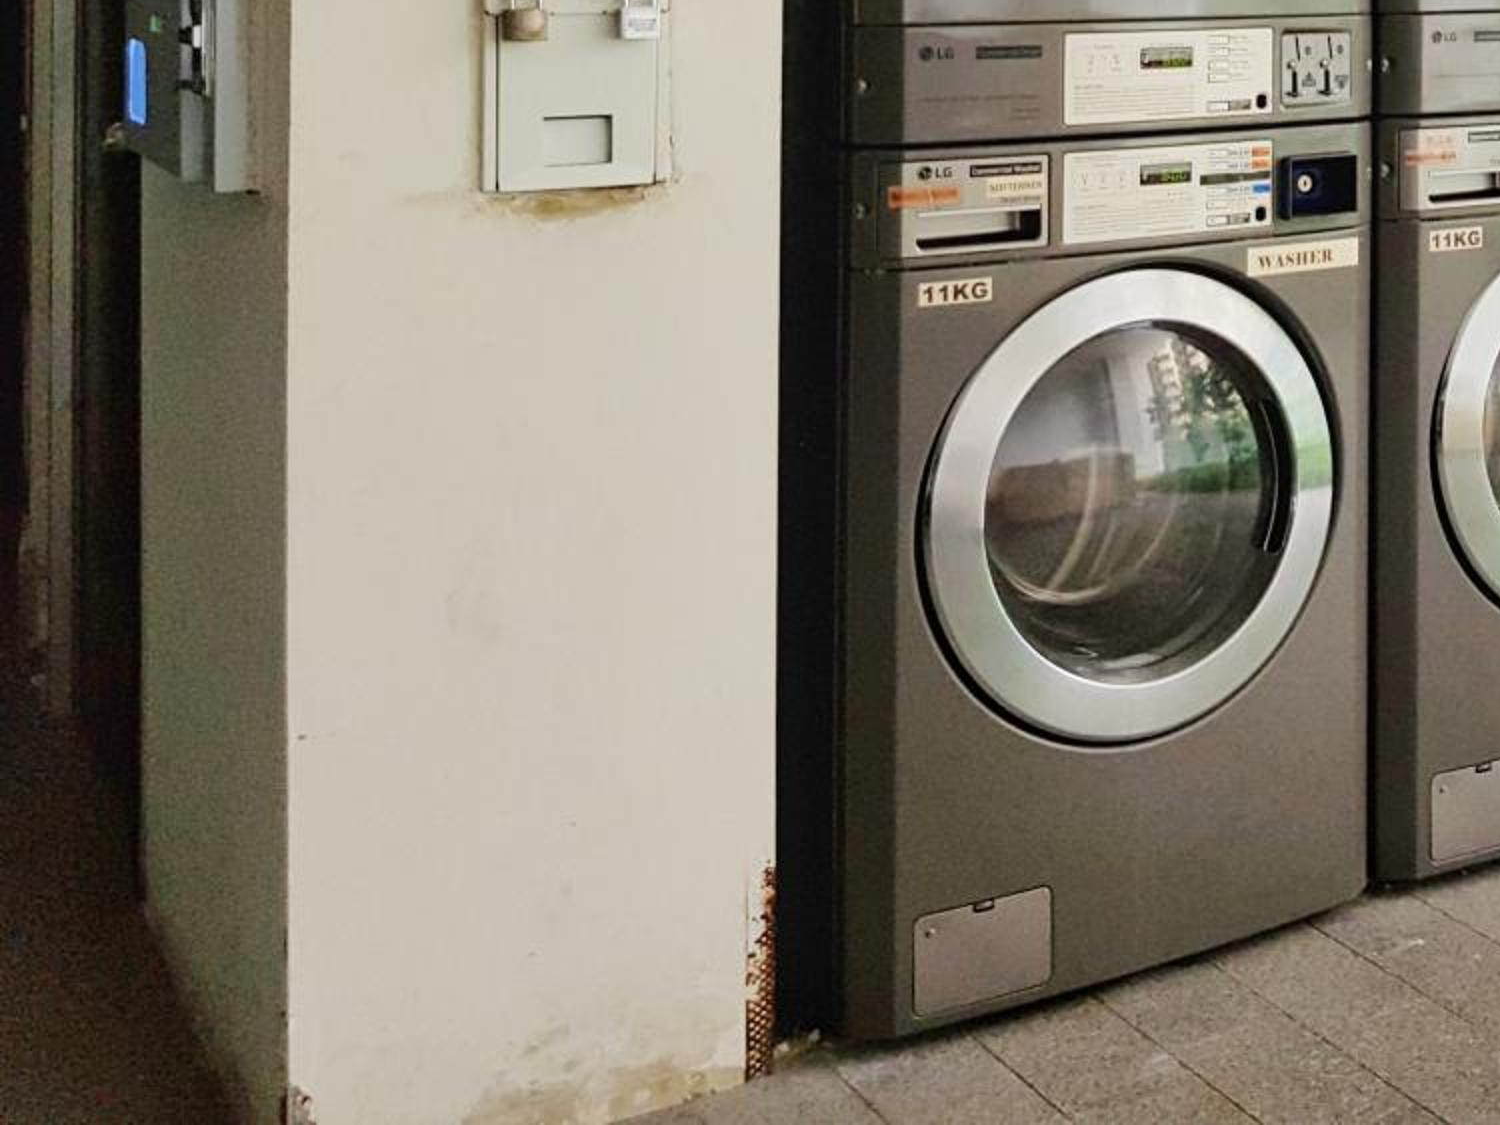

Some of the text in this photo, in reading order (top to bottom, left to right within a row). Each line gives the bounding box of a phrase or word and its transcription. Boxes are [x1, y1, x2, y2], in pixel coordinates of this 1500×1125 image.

[936, 45, 955, 60] LG
[935, 166, 953, 179] LG
[1431, 232, 1482, 250] 11KG
[1257, 247, 1334, 269] WASHER
[921, 281, 990, 305] 11KG
